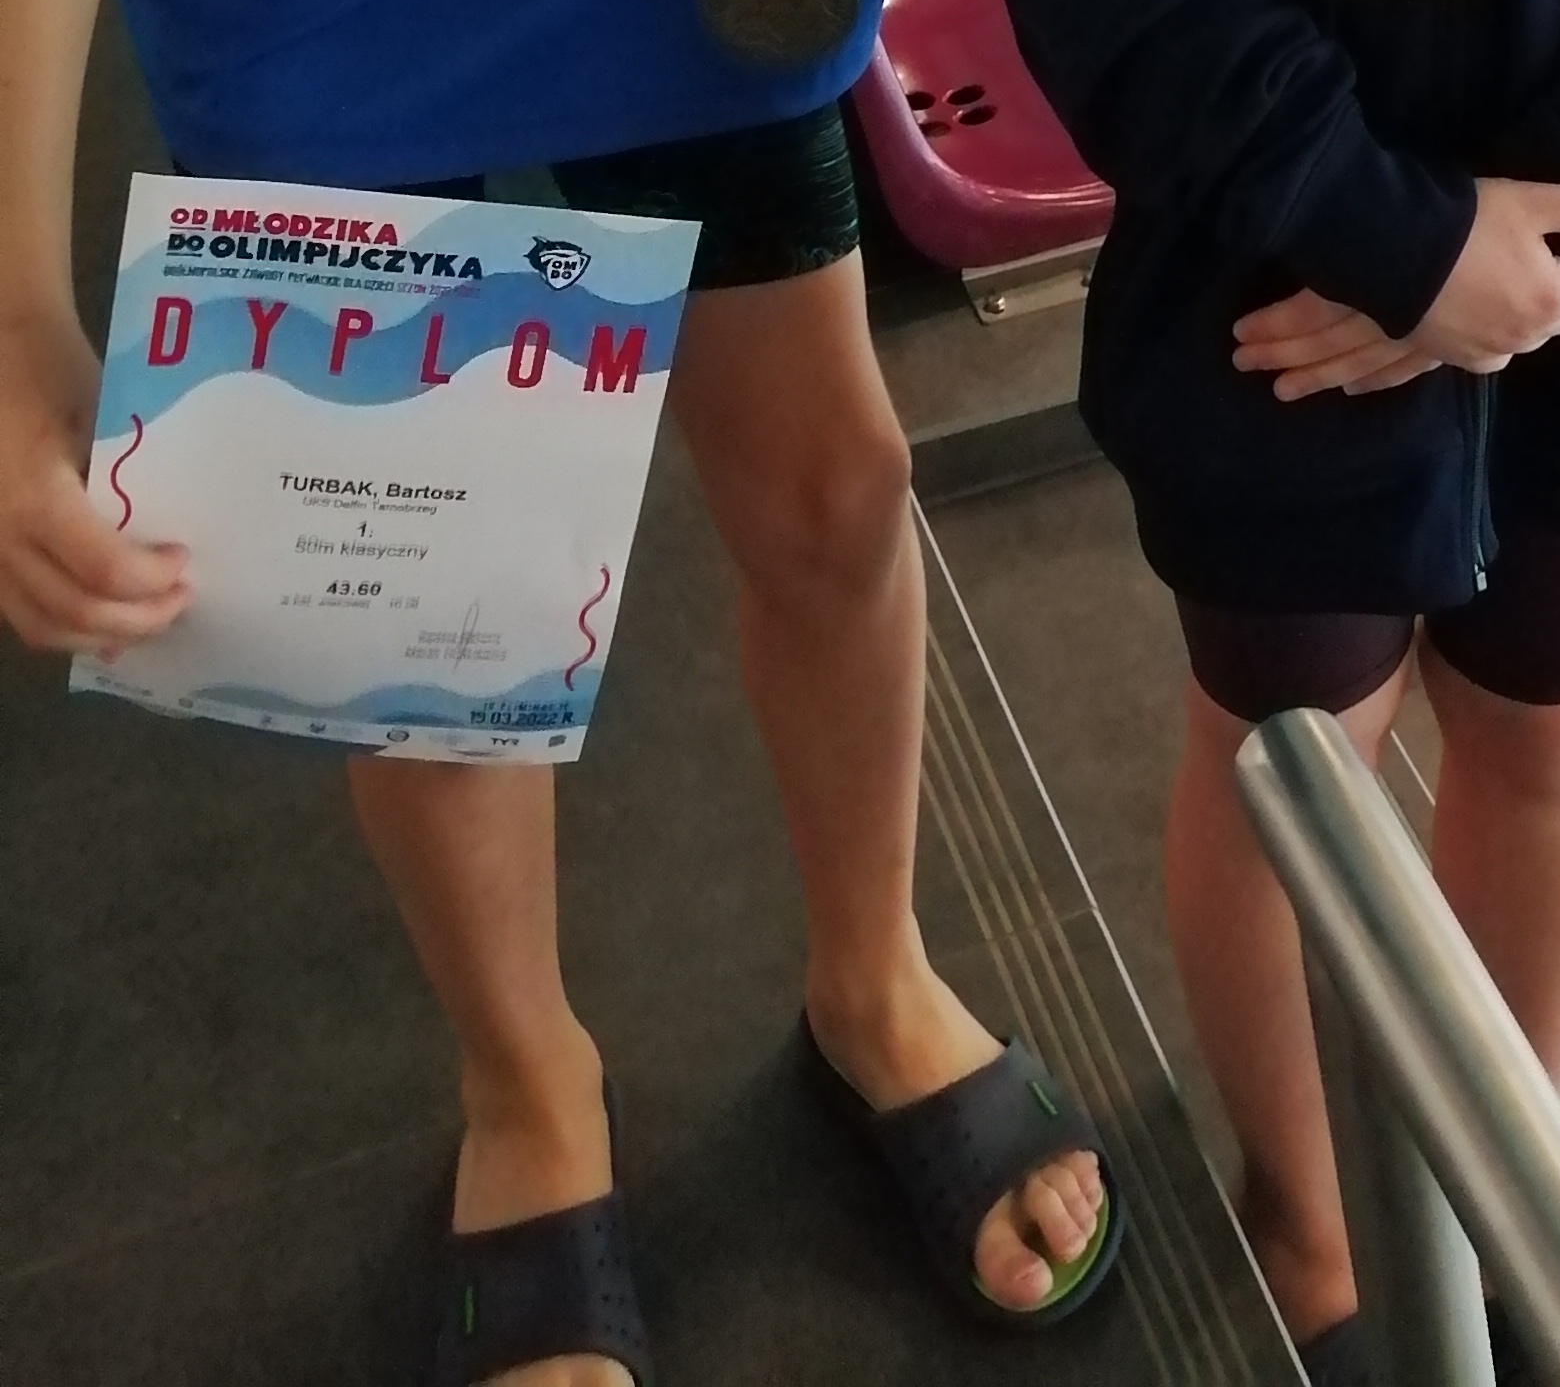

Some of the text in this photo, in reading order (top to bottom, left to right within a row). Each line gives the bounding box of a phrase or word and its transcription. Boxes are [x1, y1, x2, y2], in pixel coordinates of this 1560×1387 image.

[170, 207, 399, 247] OD MŁODZIKA
[167, 233, 483, 281] DO OLIMPIJCZYKA
[148, 297, 647, 393] DYPLOM
[280, 473, 467, 502] TURBAK, Bartosz
[340, 538, 429, 561] klasyczny
[326, 579, 382, 597] 43.60
